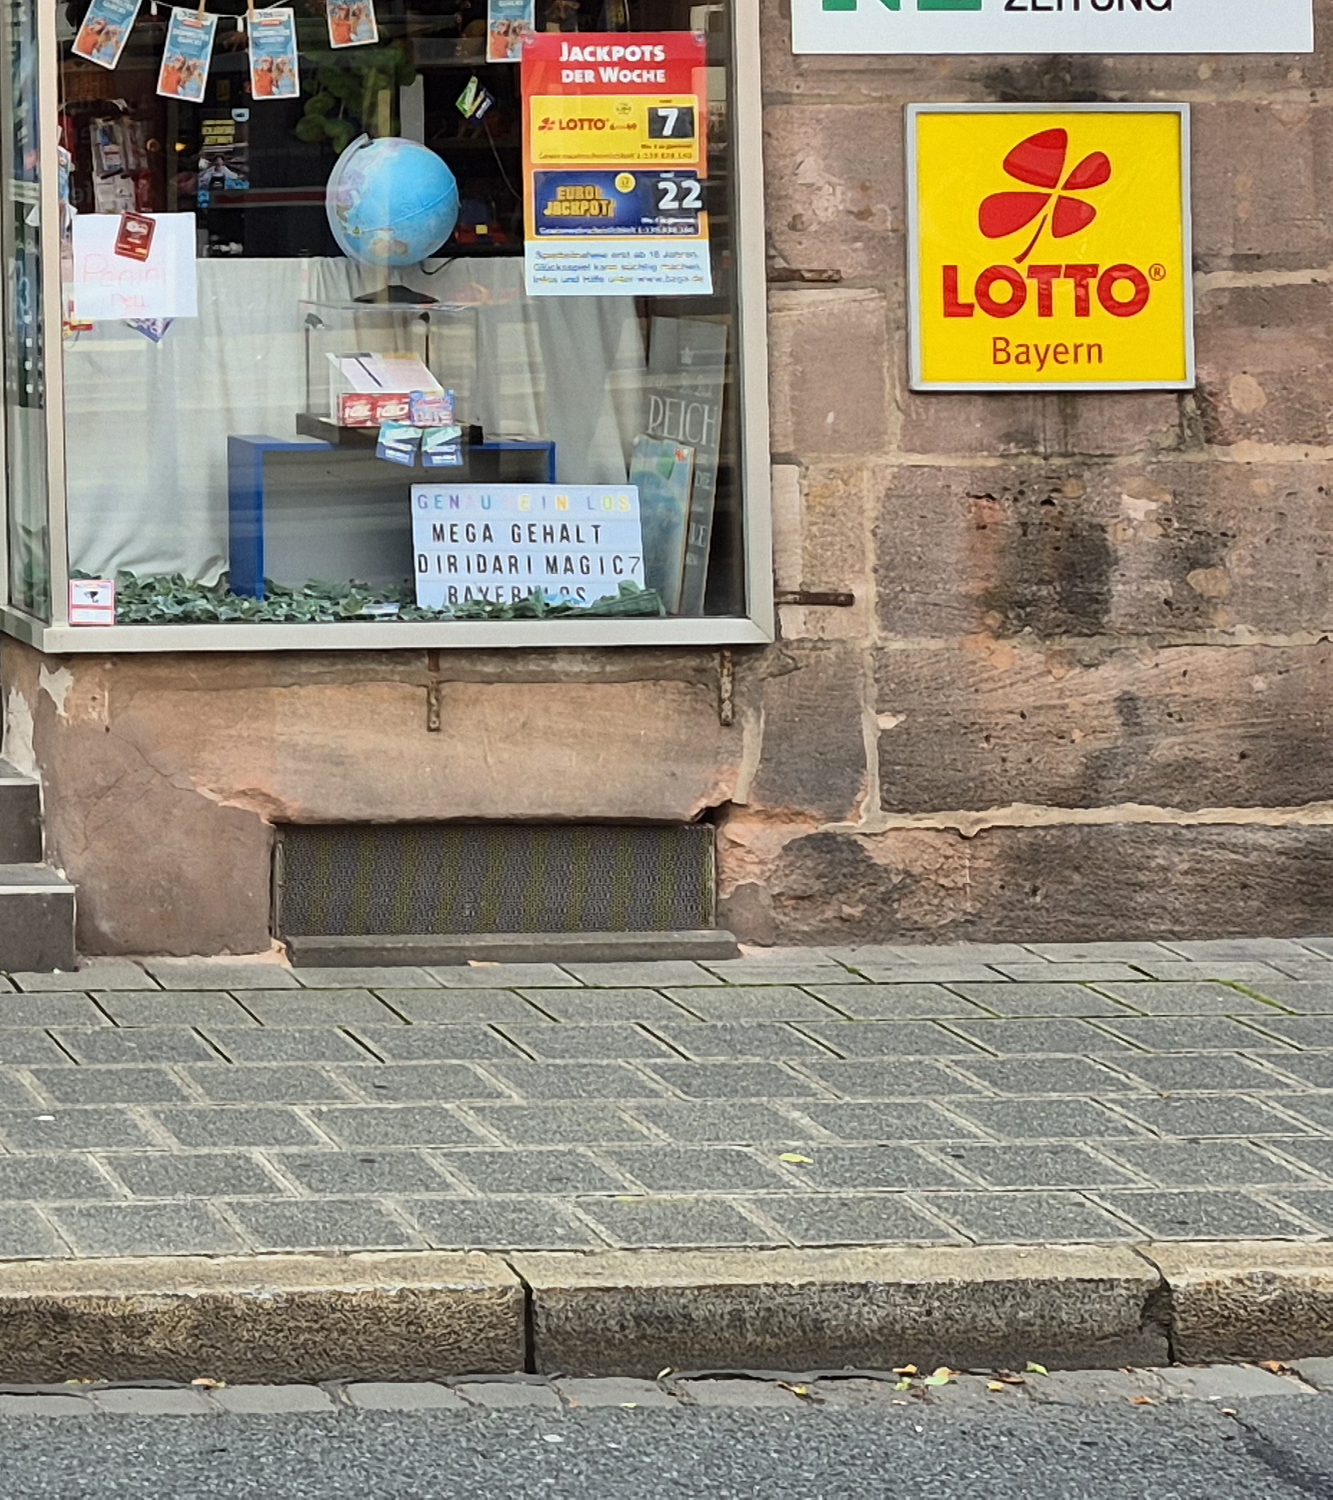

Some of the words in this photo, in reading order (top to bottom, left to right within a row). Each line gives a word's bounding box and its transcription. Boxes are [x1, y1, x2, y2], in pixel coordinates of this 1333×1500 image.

[559, 41, 666, 62] JACKPOTS
[561, 70, 595, 83] DER
[598, 66, 666, 83] WOCHE
[558, 118, 606, 131] LOTTO
[657, 108, 678, 136] 7
[657, 179, 703, 210] 22
[943, 263, 1149, 319] LOTTO
[991, 336, 1103, 371] Bayern
[587, 496, 631, 511] LOS
[432, 523, 494, 543] MEGA
[511, 523, 602, 544] GEHALT
[417, 553, 532, 574] DIRIDARI
[447, 585, 586, 604] BAYERS
